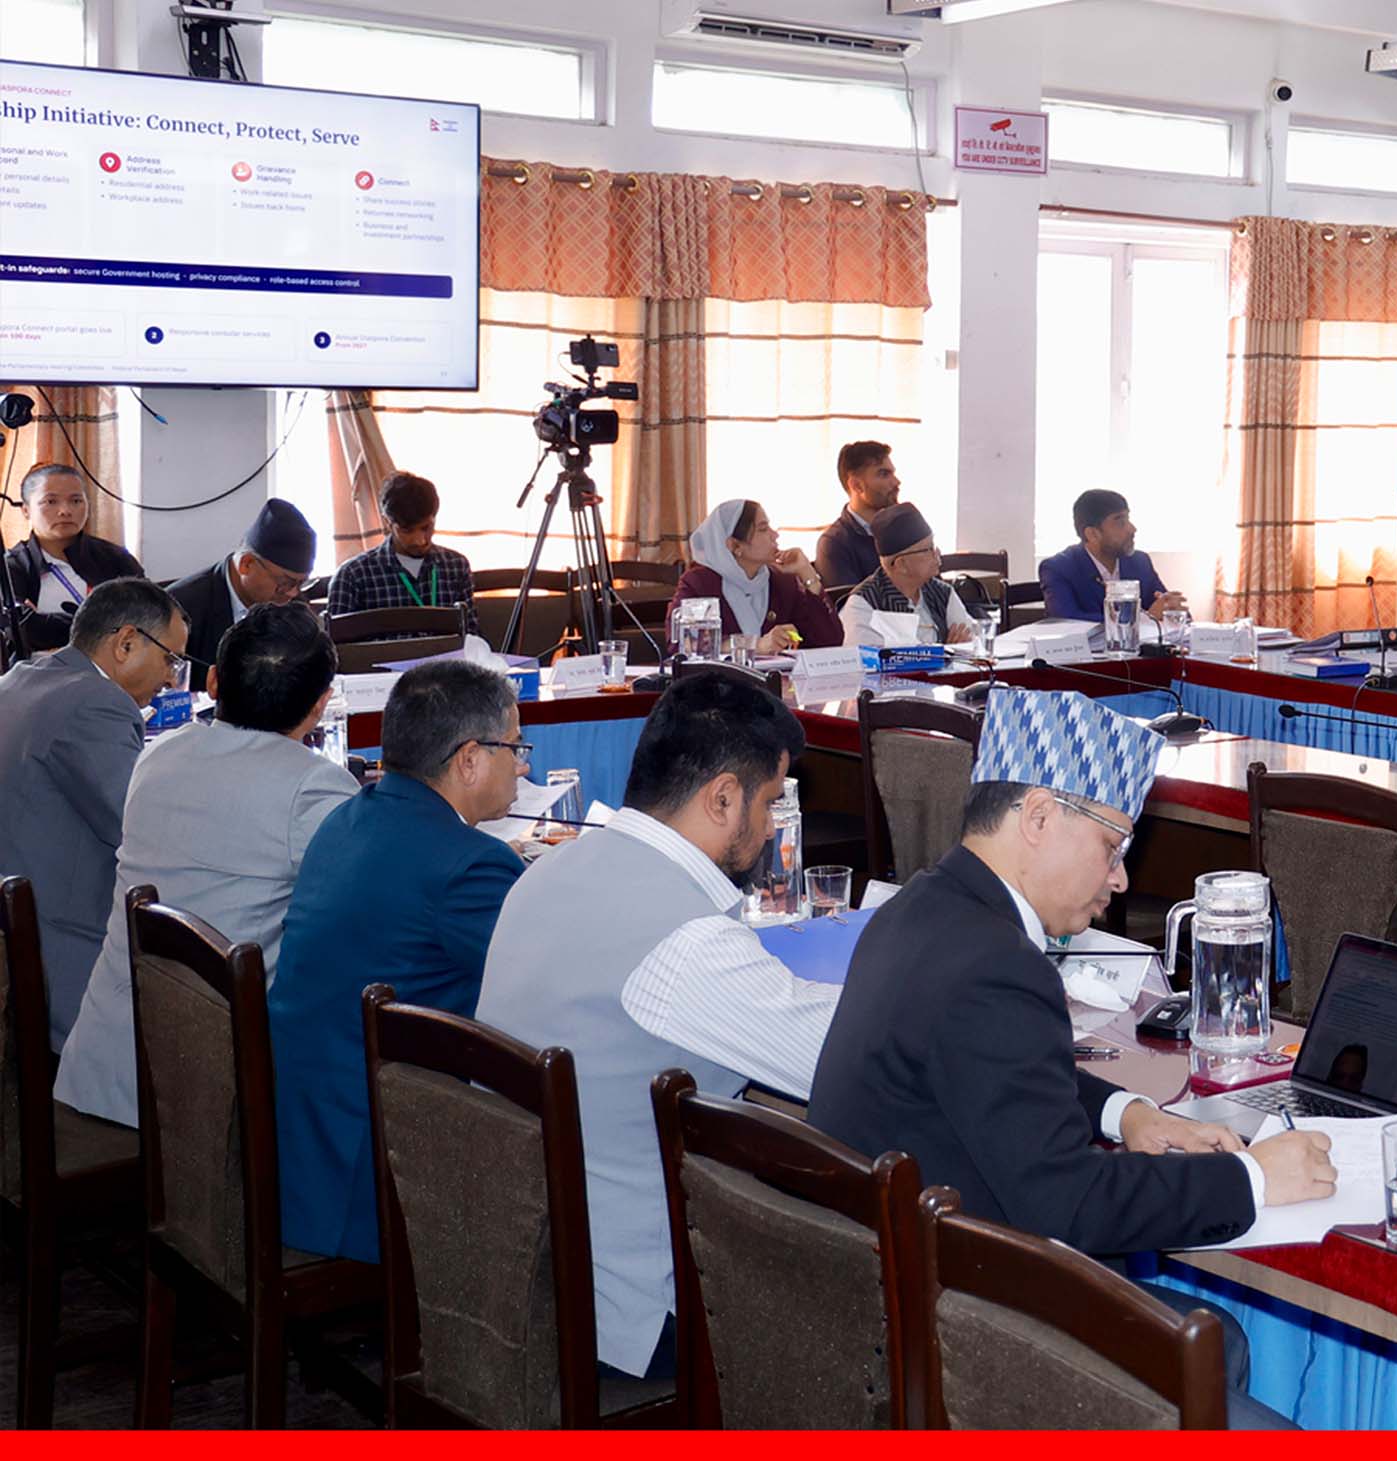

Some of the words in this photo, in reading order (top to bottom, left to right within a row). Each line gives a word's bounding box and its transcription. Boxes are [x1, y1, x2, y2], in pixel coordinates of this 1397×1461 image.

[42, 105, 141, 128] Initiative:
[146, 114, 231, 139] Connect,
[236, 121, 307, 145] Protect,
[312, 128, 360, 147] Serve
[126, 155, 161, 164] Address
[126, 165, 176, 175] Verification
[256, 164, 296, 174] Grievance
[378, 176, 411, 187] Connect
[102, 267, 150, 279] Government
[152, 270, 180, 281] hosting
[218, 273, 260, 284] compliance
